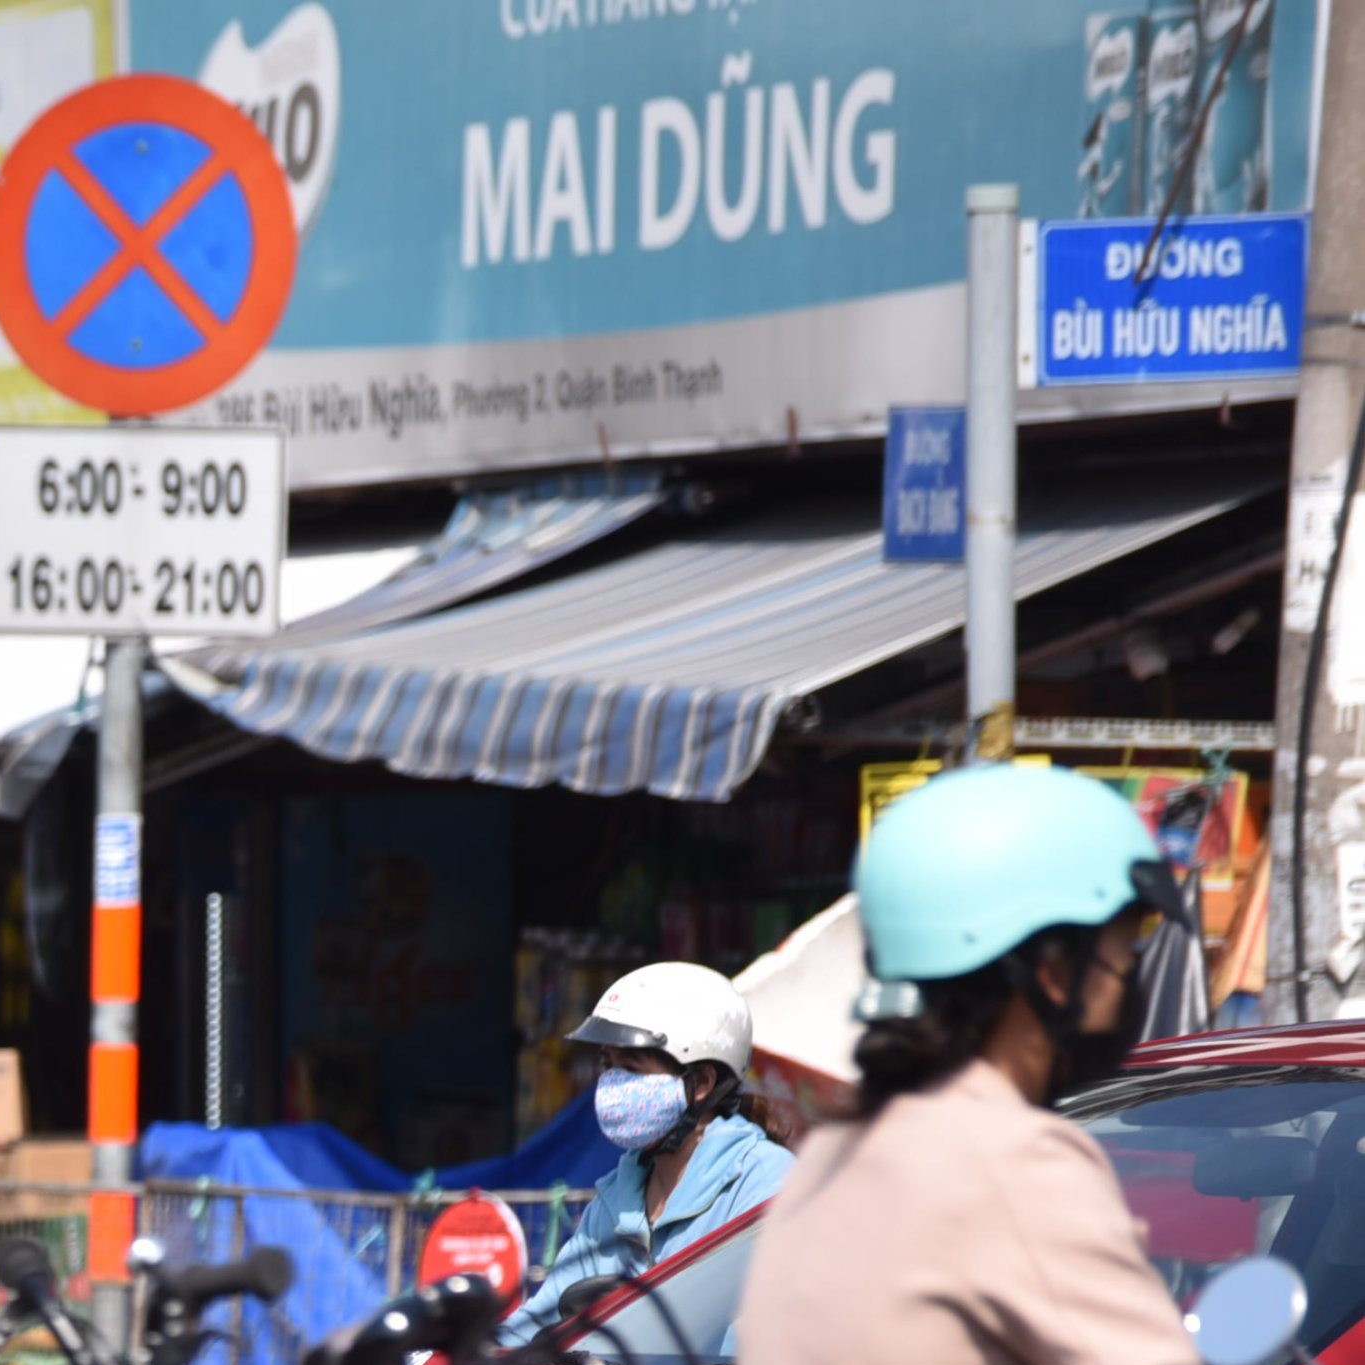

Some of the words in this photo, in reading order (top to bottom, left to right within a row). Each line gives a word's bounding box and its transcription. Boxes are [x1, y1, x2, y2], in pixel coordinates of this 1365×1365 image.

[461, 105, 617, 270] MAI
[638, 50, 896, 250] DŨNG
[1053, 297, 1103, 360] BÙI
[1112, 297, 1181, 359] HỮU
[1189, 294, 1288, 356] NGHĨA
[38, 457, 123, 516] 6:00
[161, 458, 247, 517] 9:00
[9, 556, 125, 613] 16:00
[154, 560, 265, 616] 21:00
